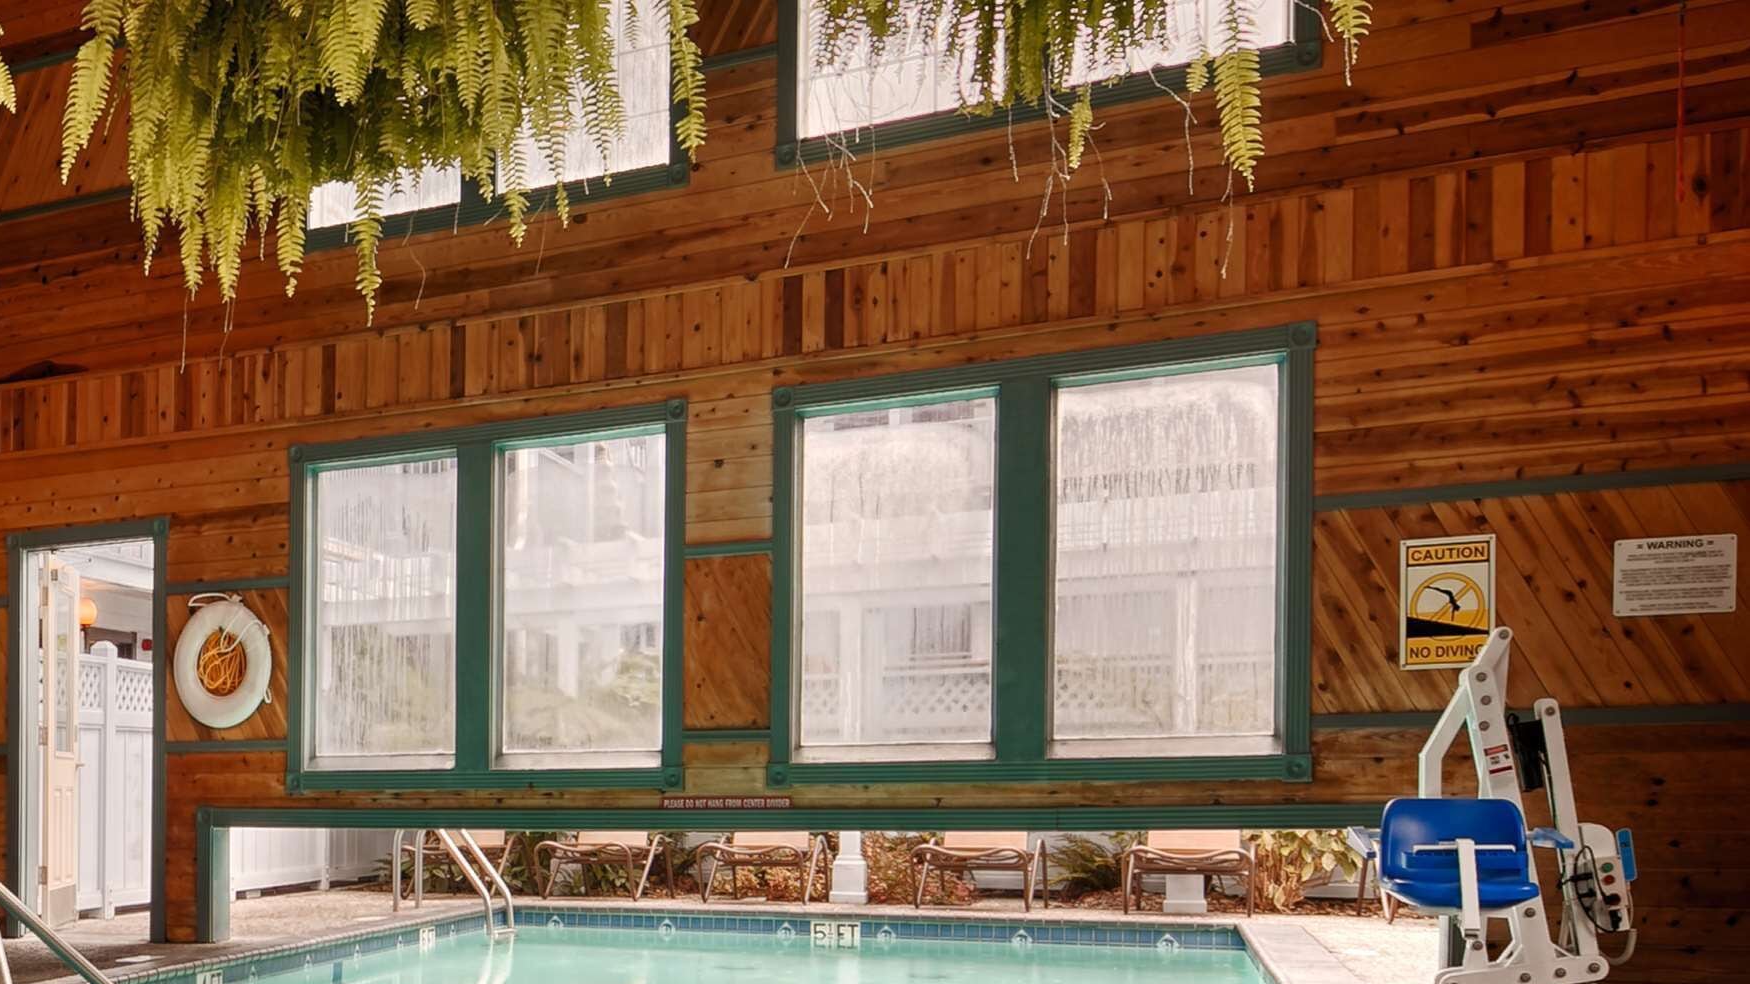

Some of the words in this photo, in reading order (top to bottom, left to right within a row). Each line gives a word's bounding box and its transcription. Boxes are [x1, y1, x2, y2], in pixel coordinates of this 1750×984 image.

[1646, 539, 1704, 549] WARNING
[1411, 546, 1485, 561] CAUTION
[1410, 646, 1431, 658] NO
